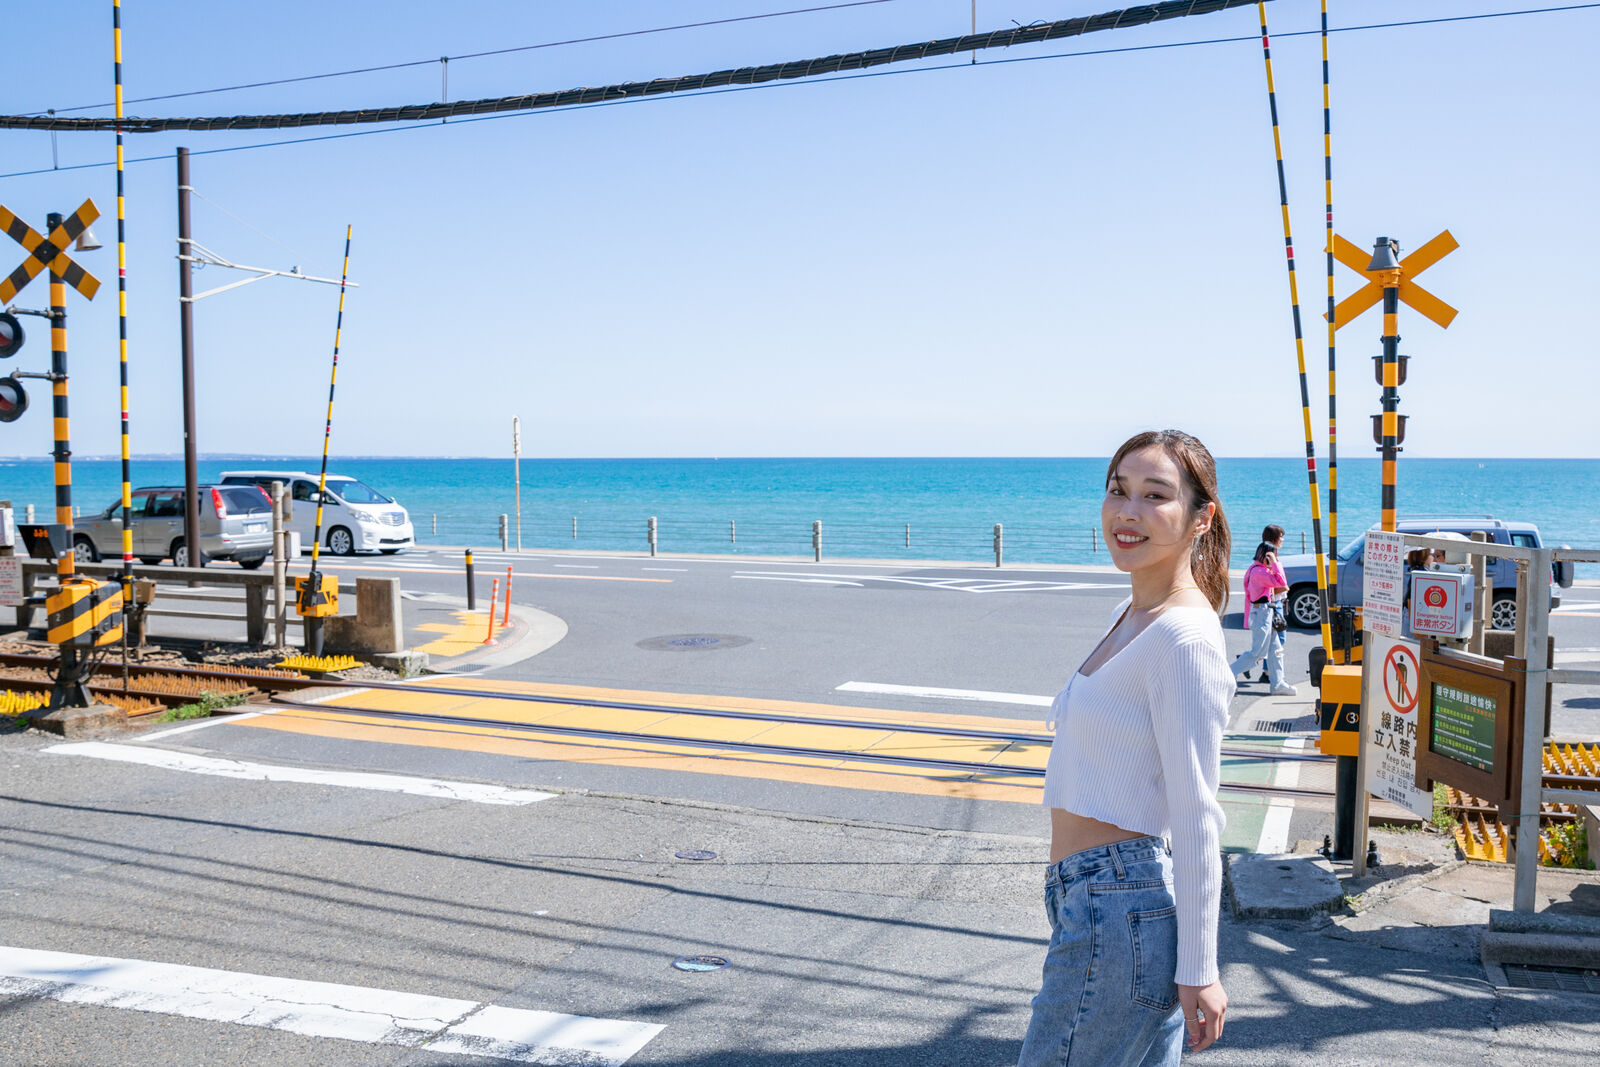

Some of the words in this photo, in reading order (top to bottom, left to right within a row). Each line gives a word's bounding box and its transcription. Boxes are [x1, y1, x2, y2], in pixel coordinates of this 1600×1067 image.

[1416, 611, 1439, 620] Emergency
[1415, 618, 1455, 630] 非常ボタン
[1374, 728, 1417, 760] 立入禁
[1386, 753, 1400, 765] Keep
[1400, 759, 1412, 770] Out
